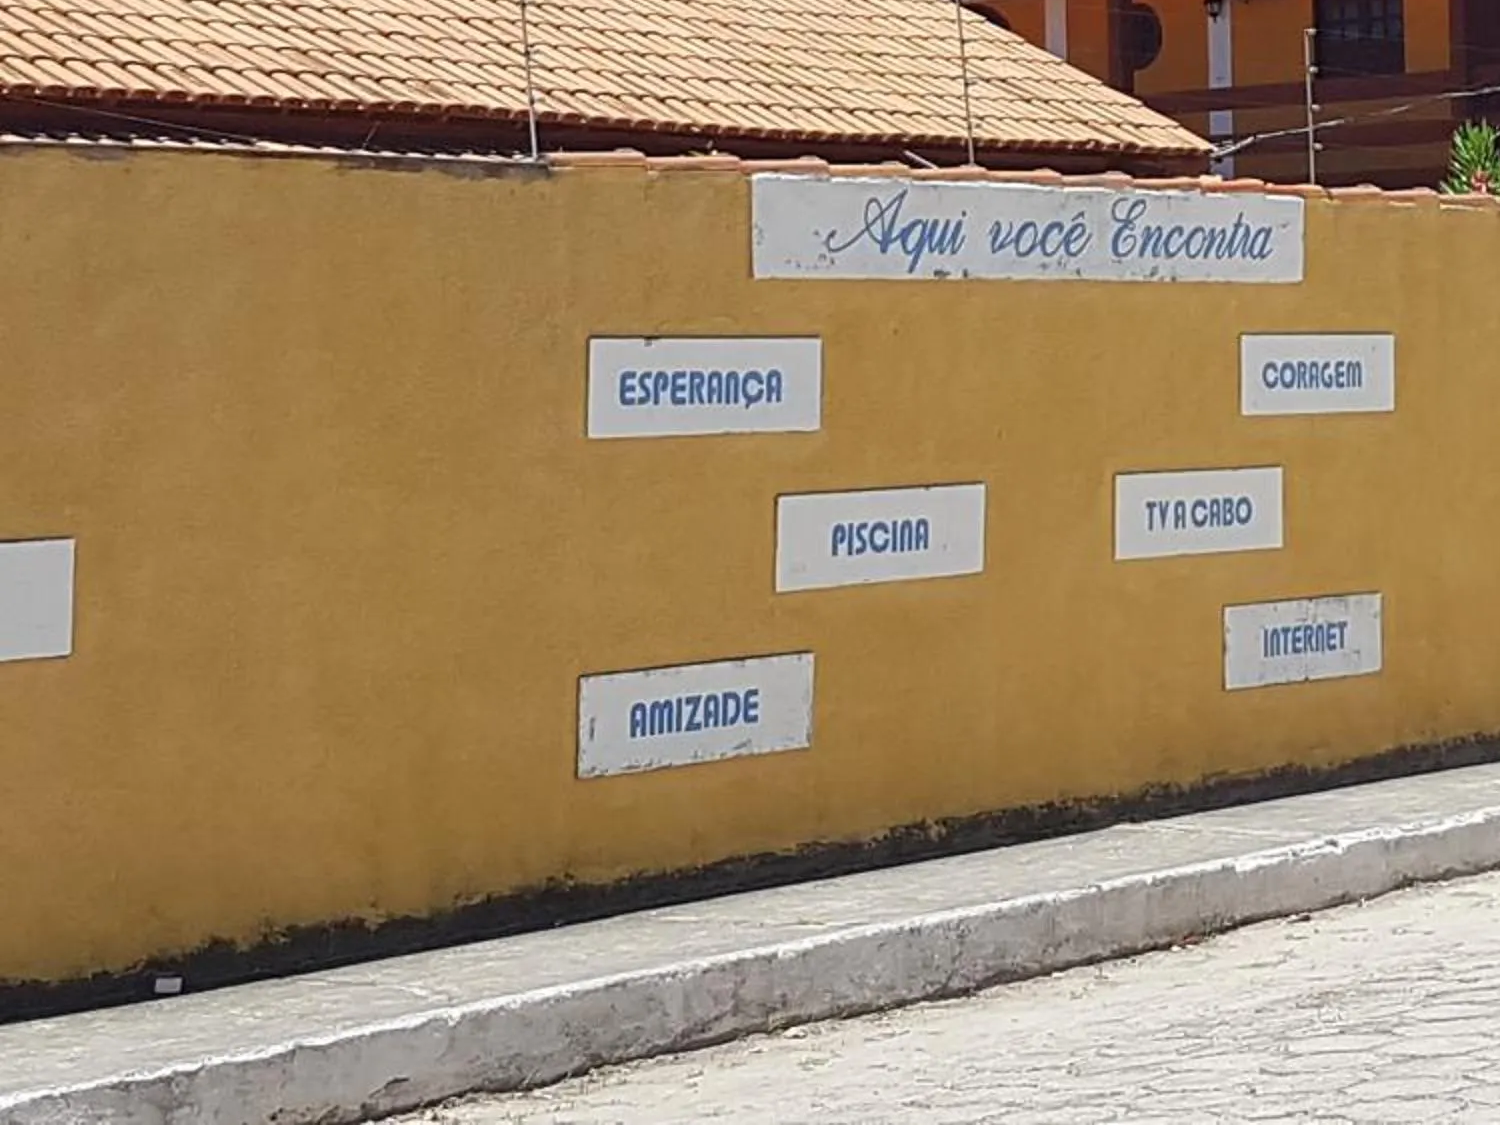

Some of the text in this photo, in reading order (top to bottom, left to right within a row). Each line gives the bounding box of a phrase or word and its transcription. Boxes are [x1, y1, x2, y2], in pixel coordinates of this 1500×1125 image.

[825, 190, 1274, 272] Aqui você Encontra
[619, 369, 782, 409] ESPERANÇA
[1262, 360, 1362, 390] CORAGEM
[1145, 496, 1253, 531] TV A CABO
[831, 518, 929, 557] PISCINA
[1263, 621, 1348, 658] INTERNET
[629, 688, 760, 739] AMIZADE
